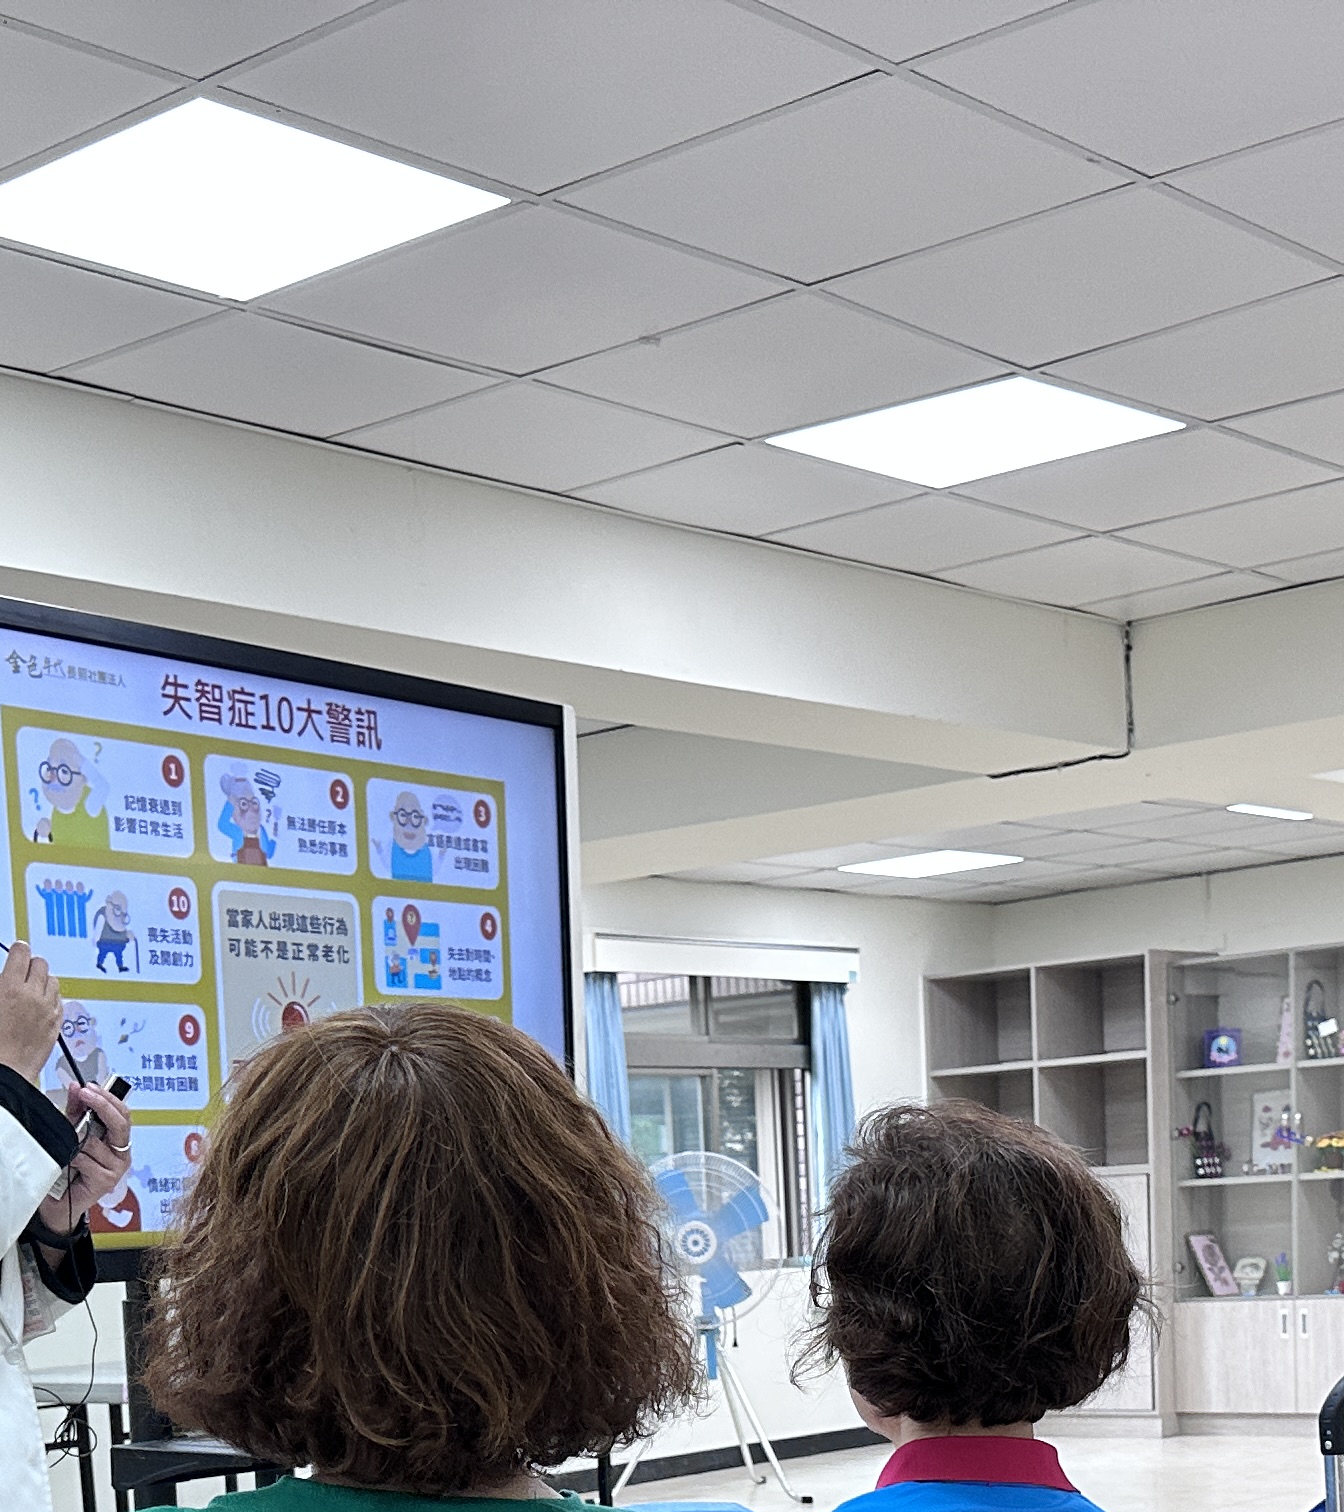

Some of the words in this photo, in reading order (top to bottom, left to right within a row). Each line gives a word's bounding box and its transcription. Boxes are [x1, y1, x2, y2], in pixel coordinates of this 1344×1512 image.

[161, 673, 383, 751] 失智症10大警訊
[171, 895, 189, 913] 10
[226, 907, 349, 937] 當家人出現這些行為
[227, 937, 351, 965] 可能不是正常老化
[123, 1075, 199, 1092] 決問題有困難
